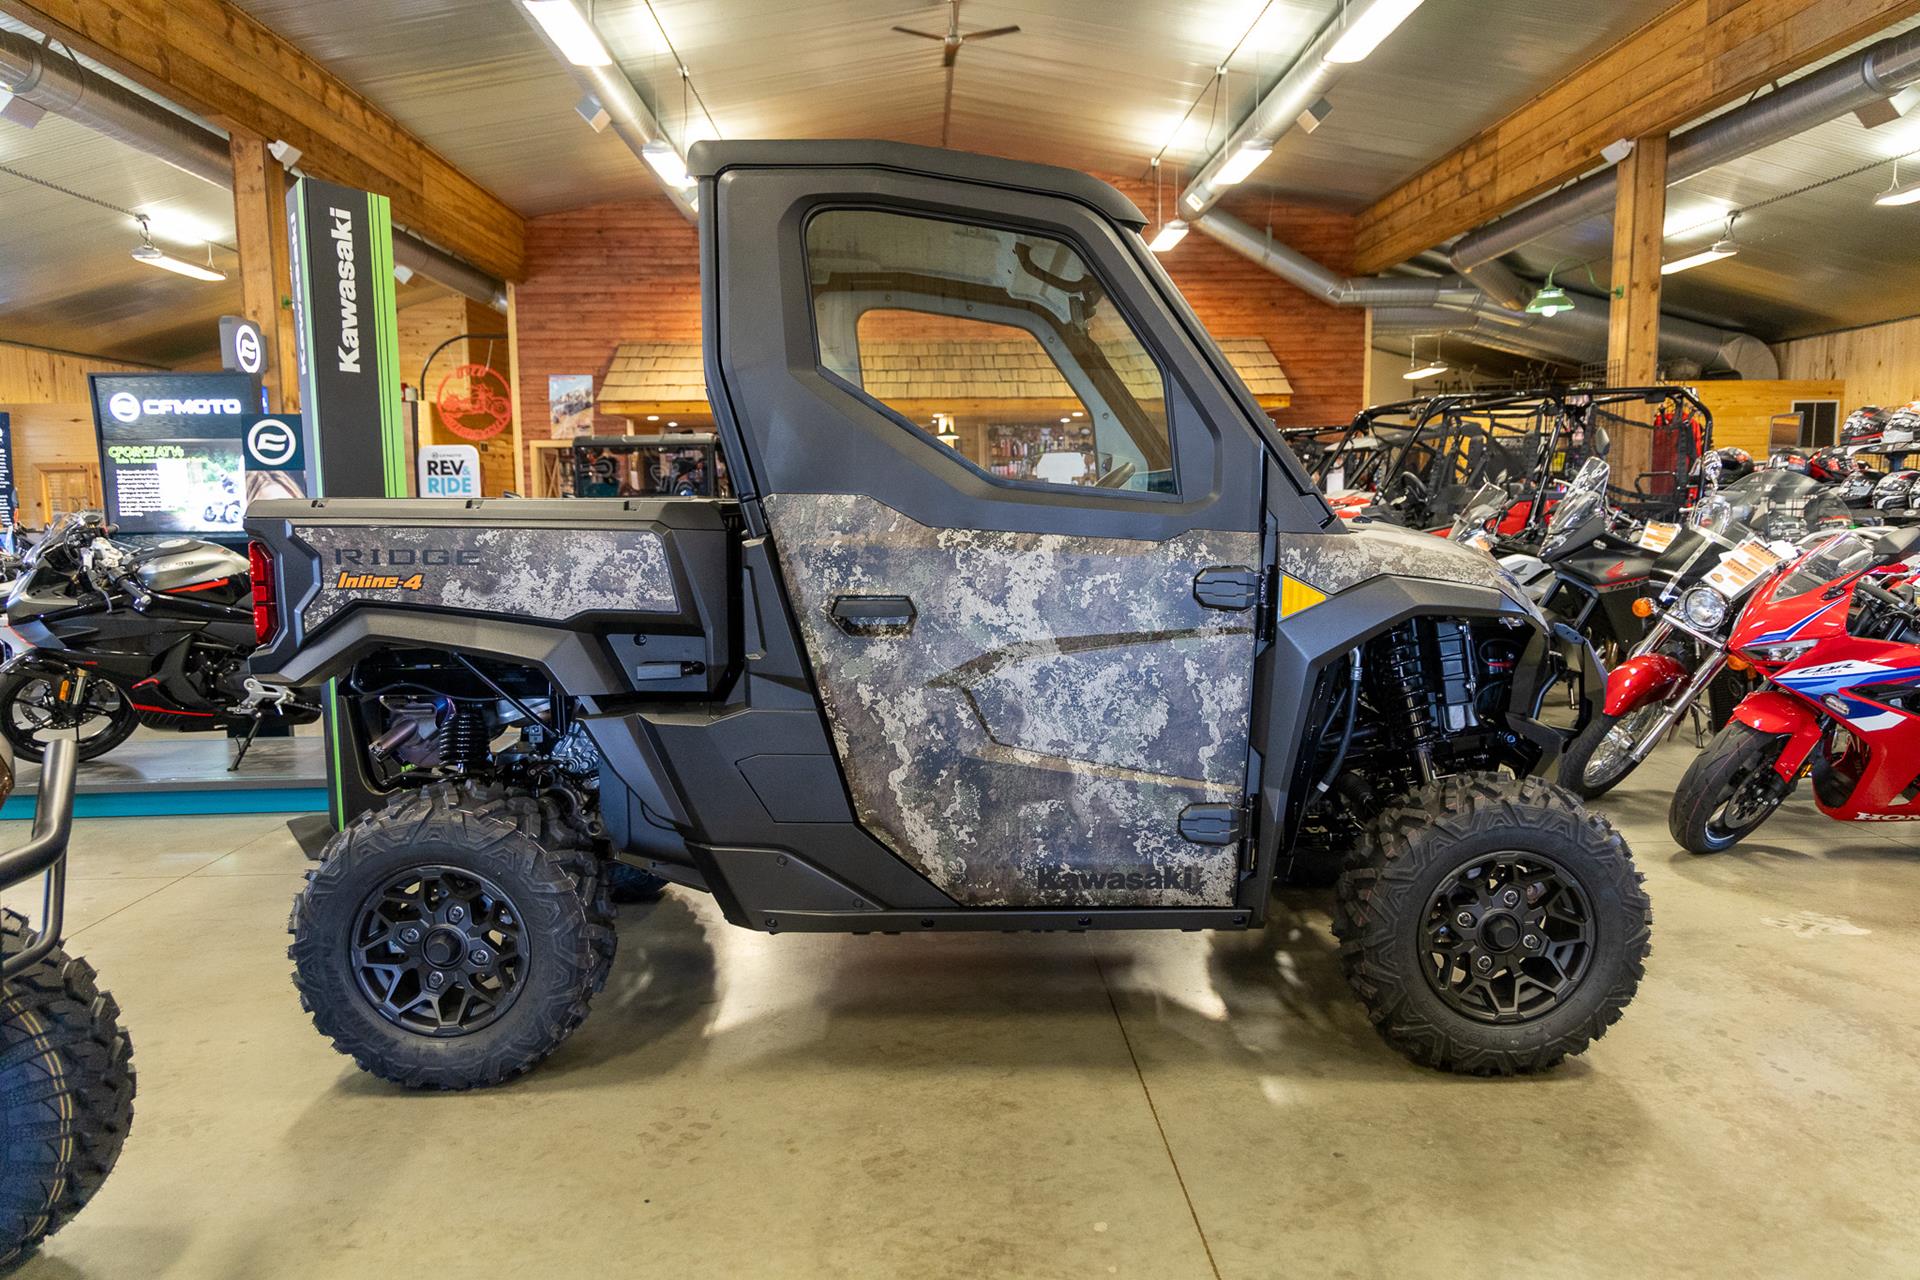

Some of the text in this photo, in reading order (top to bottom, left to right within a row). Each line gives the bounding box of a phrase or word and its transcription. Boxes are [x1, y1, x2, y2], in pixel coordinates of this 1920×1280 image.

[329, 207, 361, 373] Kawasaki
[142, 398, 242, 415] CFMOTO
[427, 460, 464, 475] REV
[428, 478, 471, 496] RIDE
[335, 549, 480, 565] RIDGE
[336, 571, 424, 590] Inline-4
[1037, 866, 1193, 890] Kawasaki
